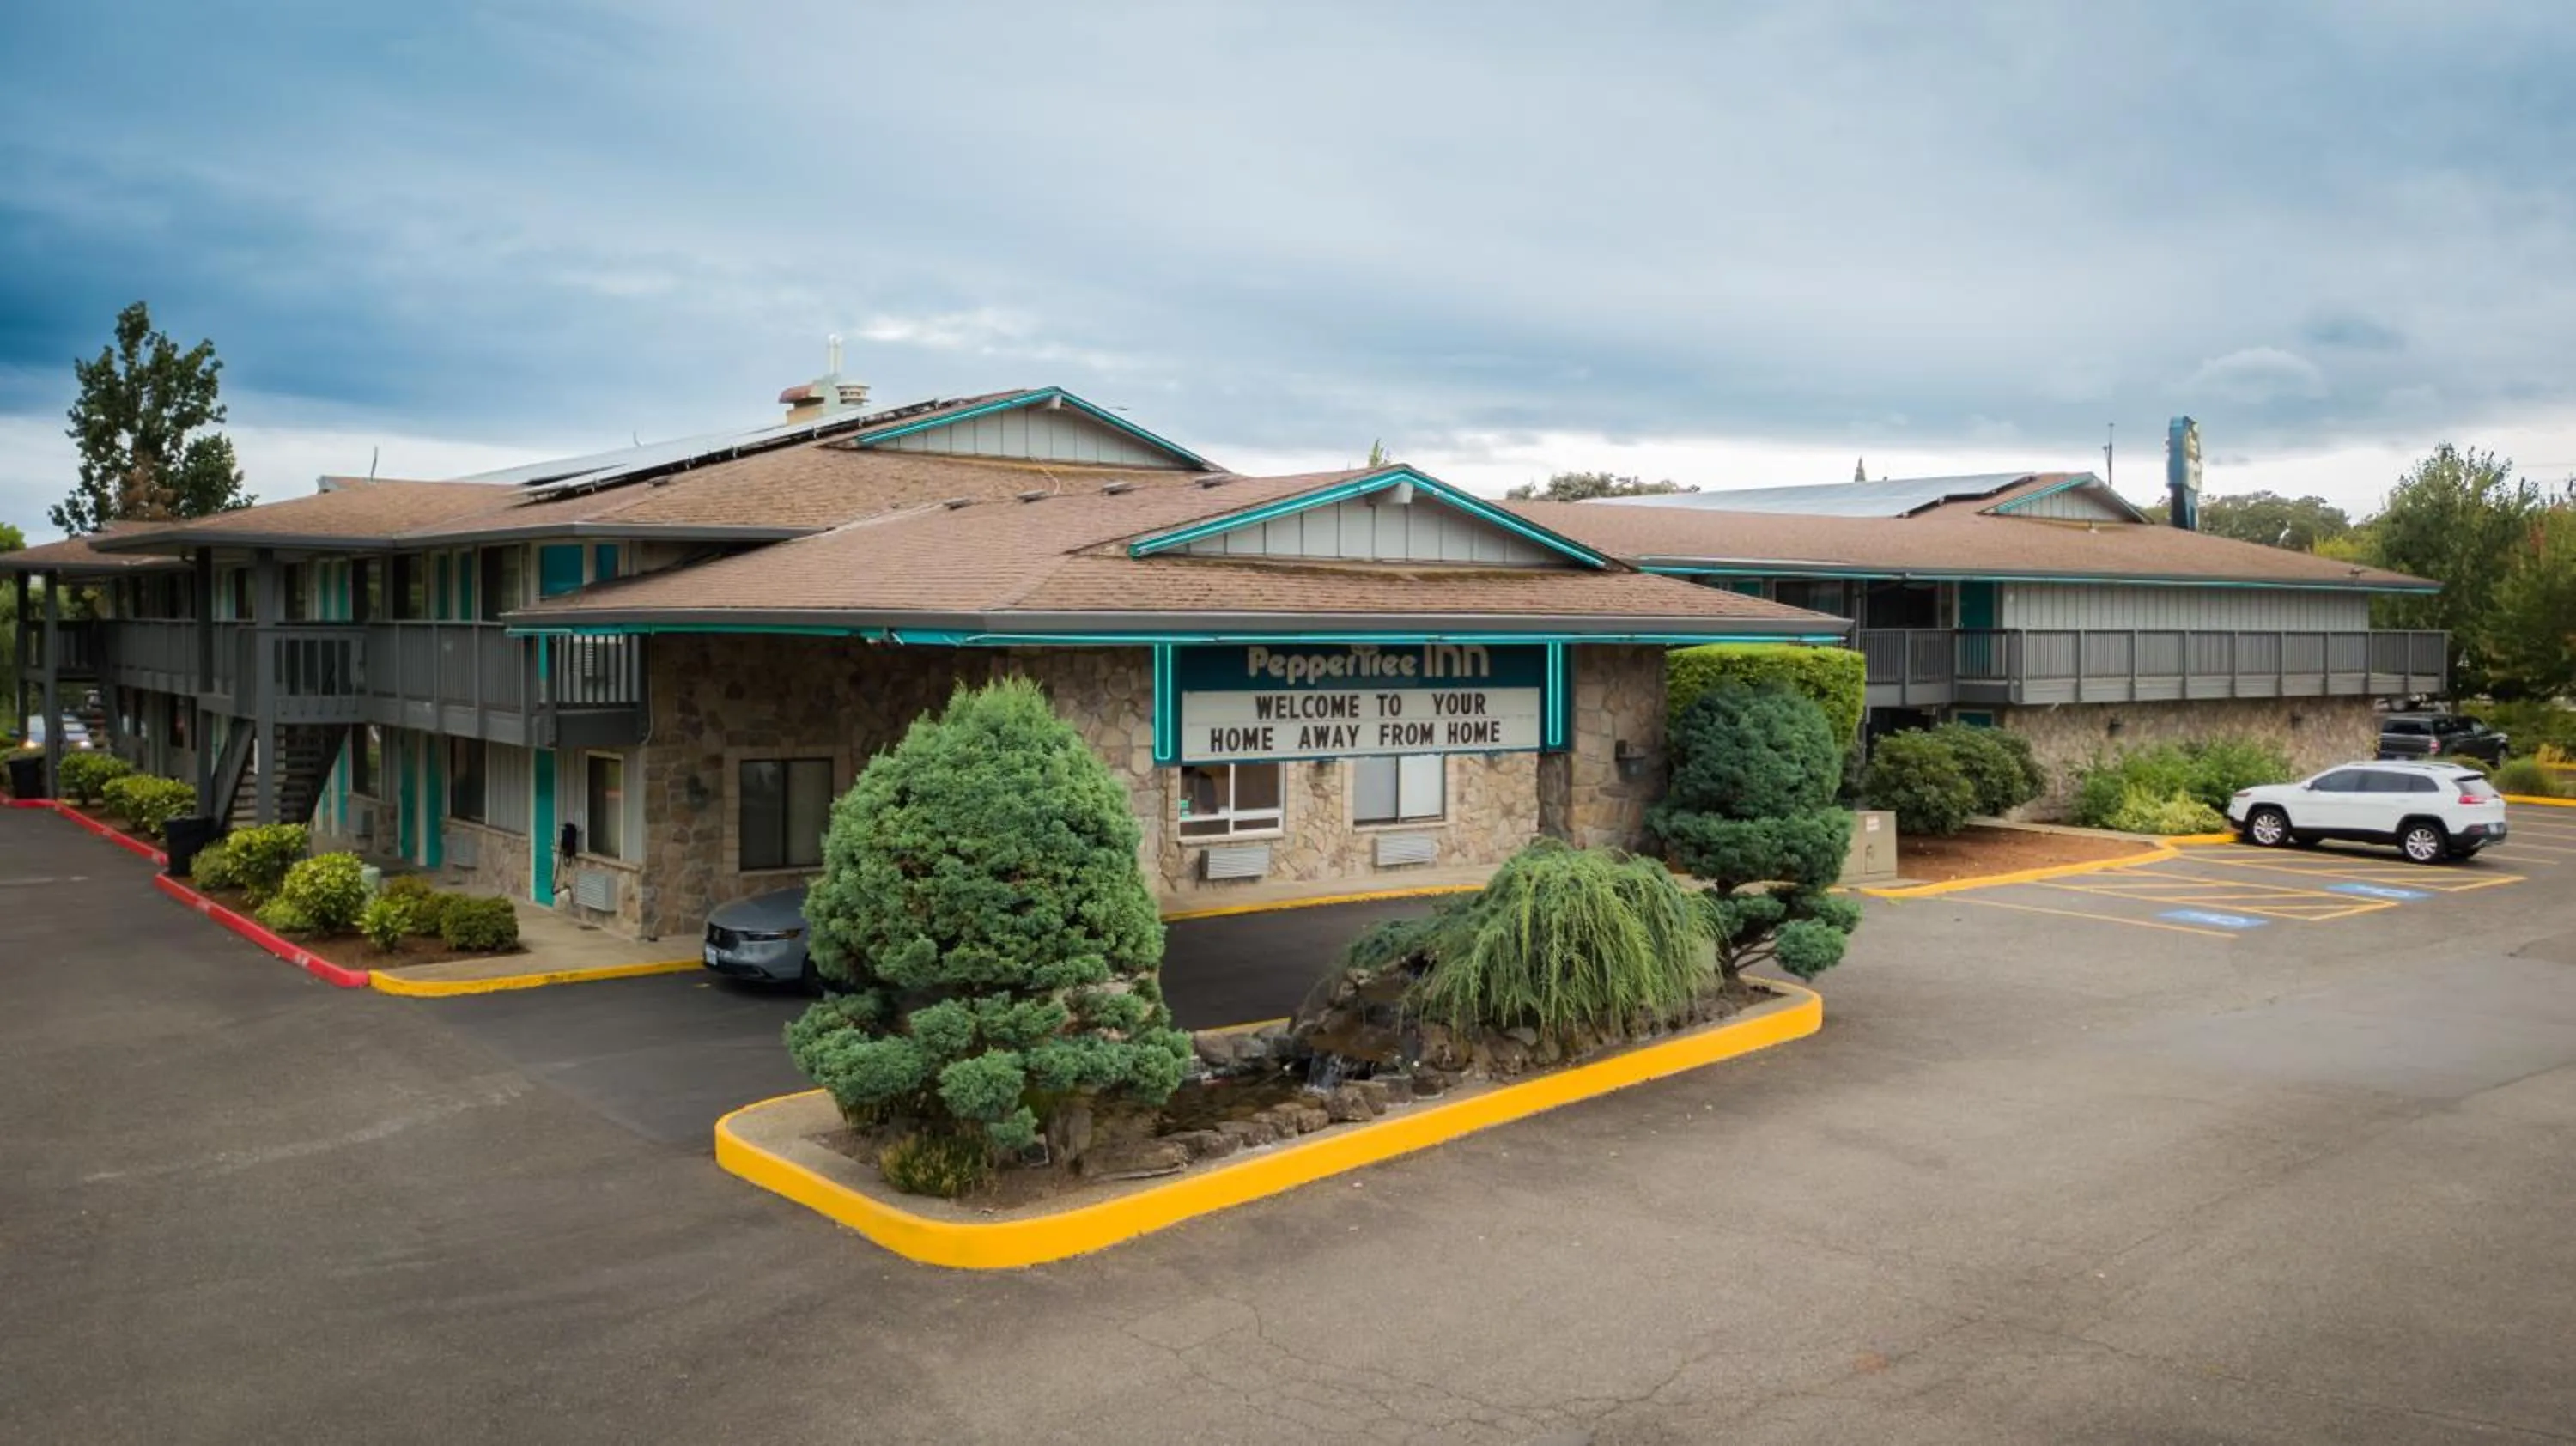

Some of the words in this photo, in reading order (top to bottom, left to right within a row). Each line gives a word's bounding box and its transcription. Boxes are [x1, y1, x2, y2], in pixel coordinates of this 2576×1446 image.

[1255, 695, 1360, 720] WELCOME
[1376, 694, 1402, 717] TO
[1432, 693, 1486, 715] YOUR
[1210, 727, 1273, 753] HOME
[1298, 724, 1361, 750] AWAY
[1379, 722, 1435, 746] FROM
[1447, 720, 1500, 744] HOME
